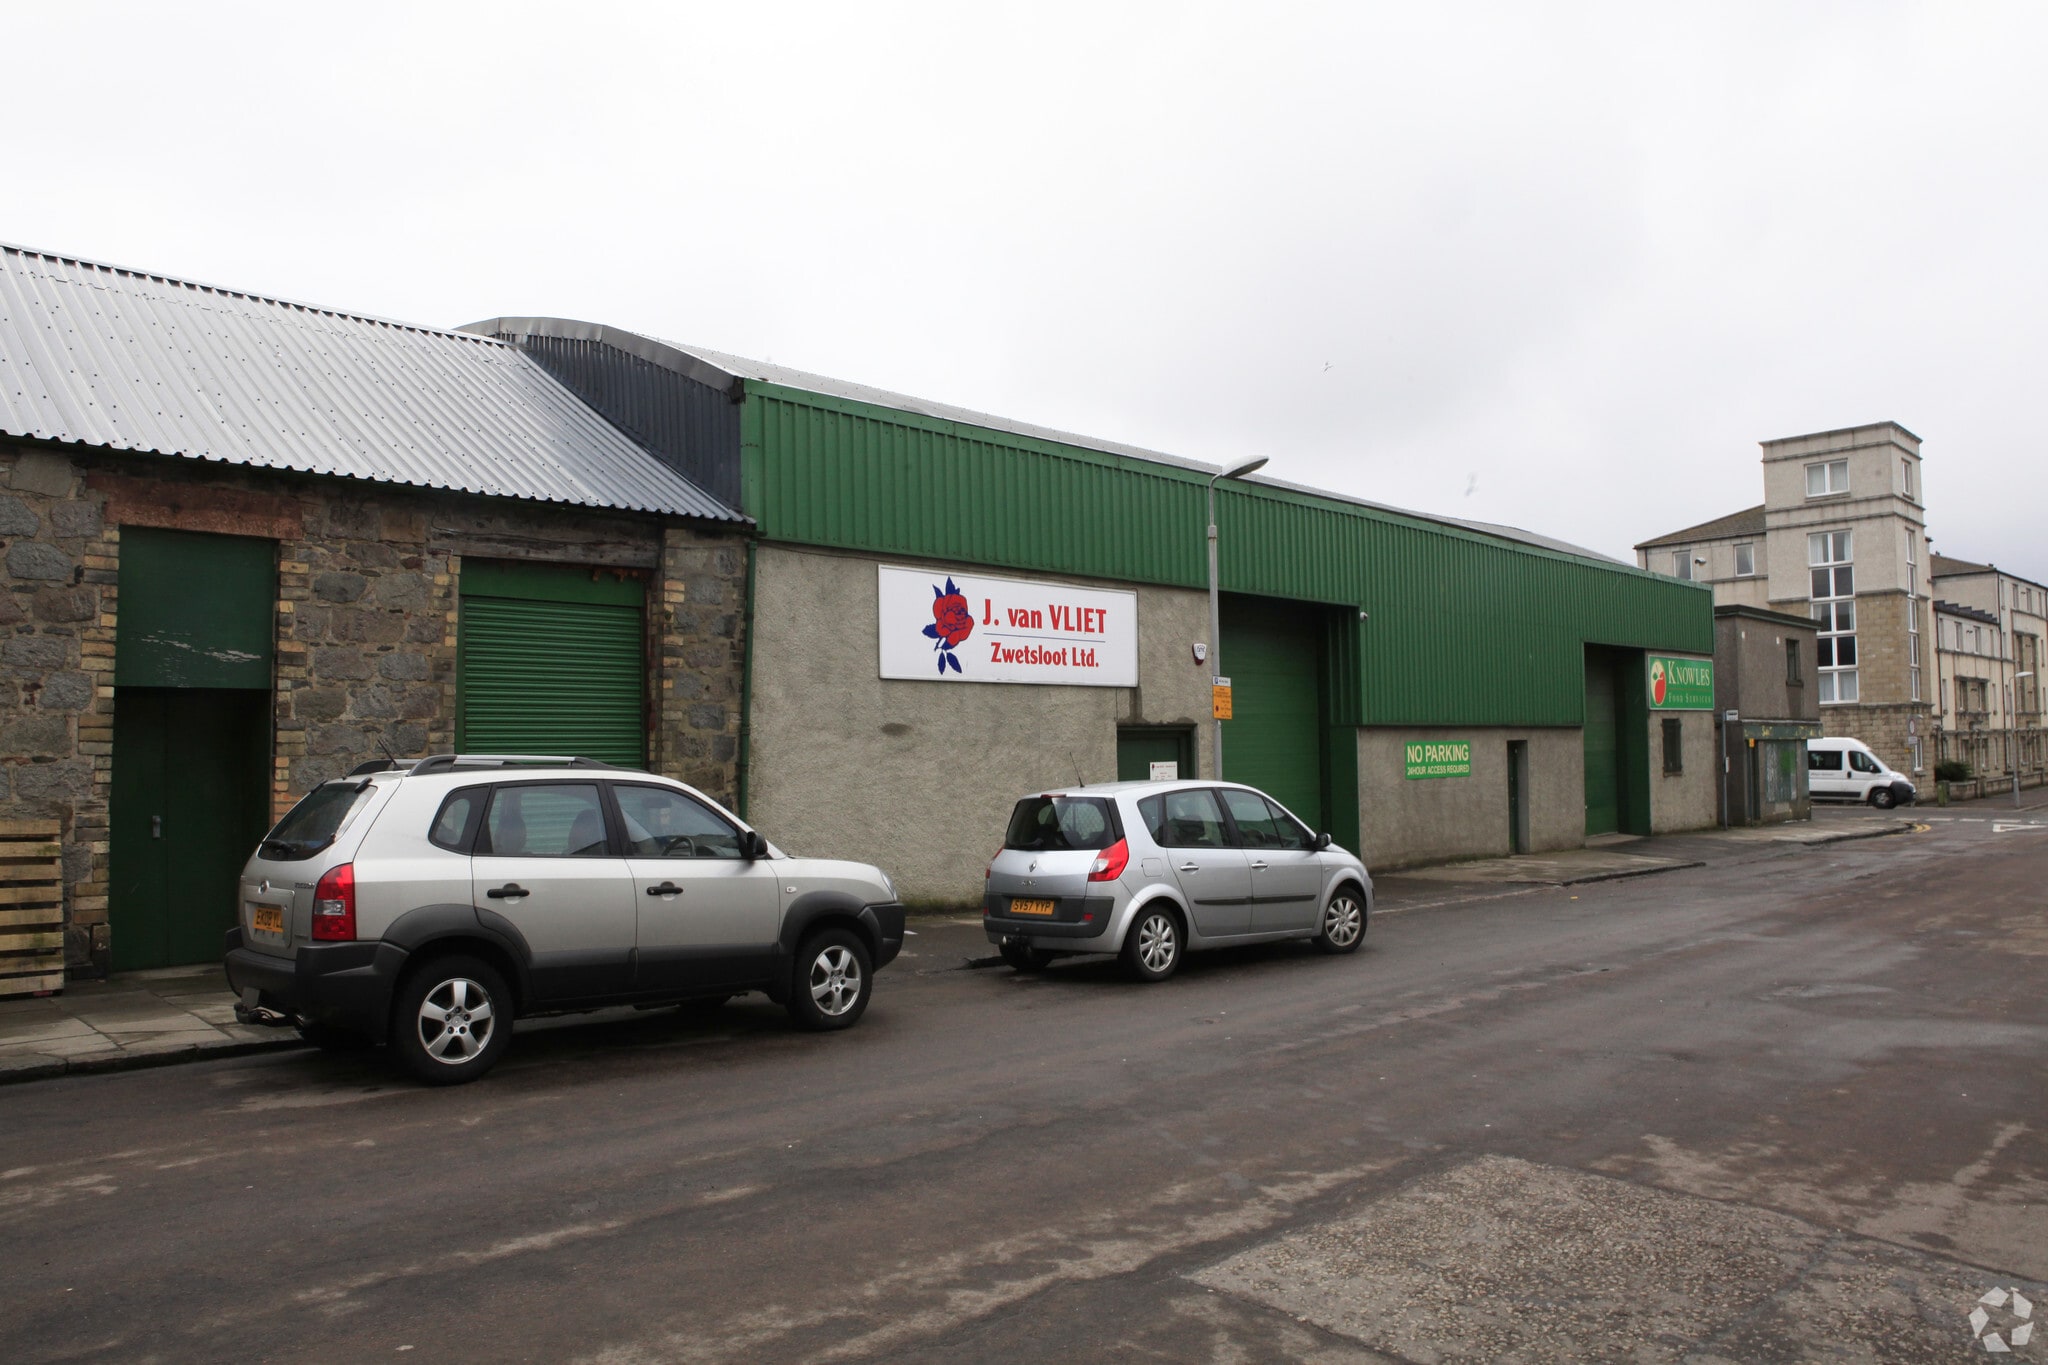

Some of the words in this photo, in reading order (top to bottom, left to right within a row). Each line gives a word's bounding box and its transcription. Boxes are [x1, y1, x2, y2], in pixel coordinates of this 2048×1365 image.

[982, 598, 1000, 626] J.
[1007, 608, 1043, 629] van
[1049, 604, 1107, 633] VLIET
[990, 642, 1068, 666] Zwetsloot
[1072, 647, 1099, 668] Ltd.
[1668, 661, 1711, 686] KNOWLES
[1407, 745, 1422, 762] NO
[1425, 744, 1469, 762] PARKING
[1427, 765, 1447, 774] ACCESS
[1447, 764, 1470, 773] REQUIRED
